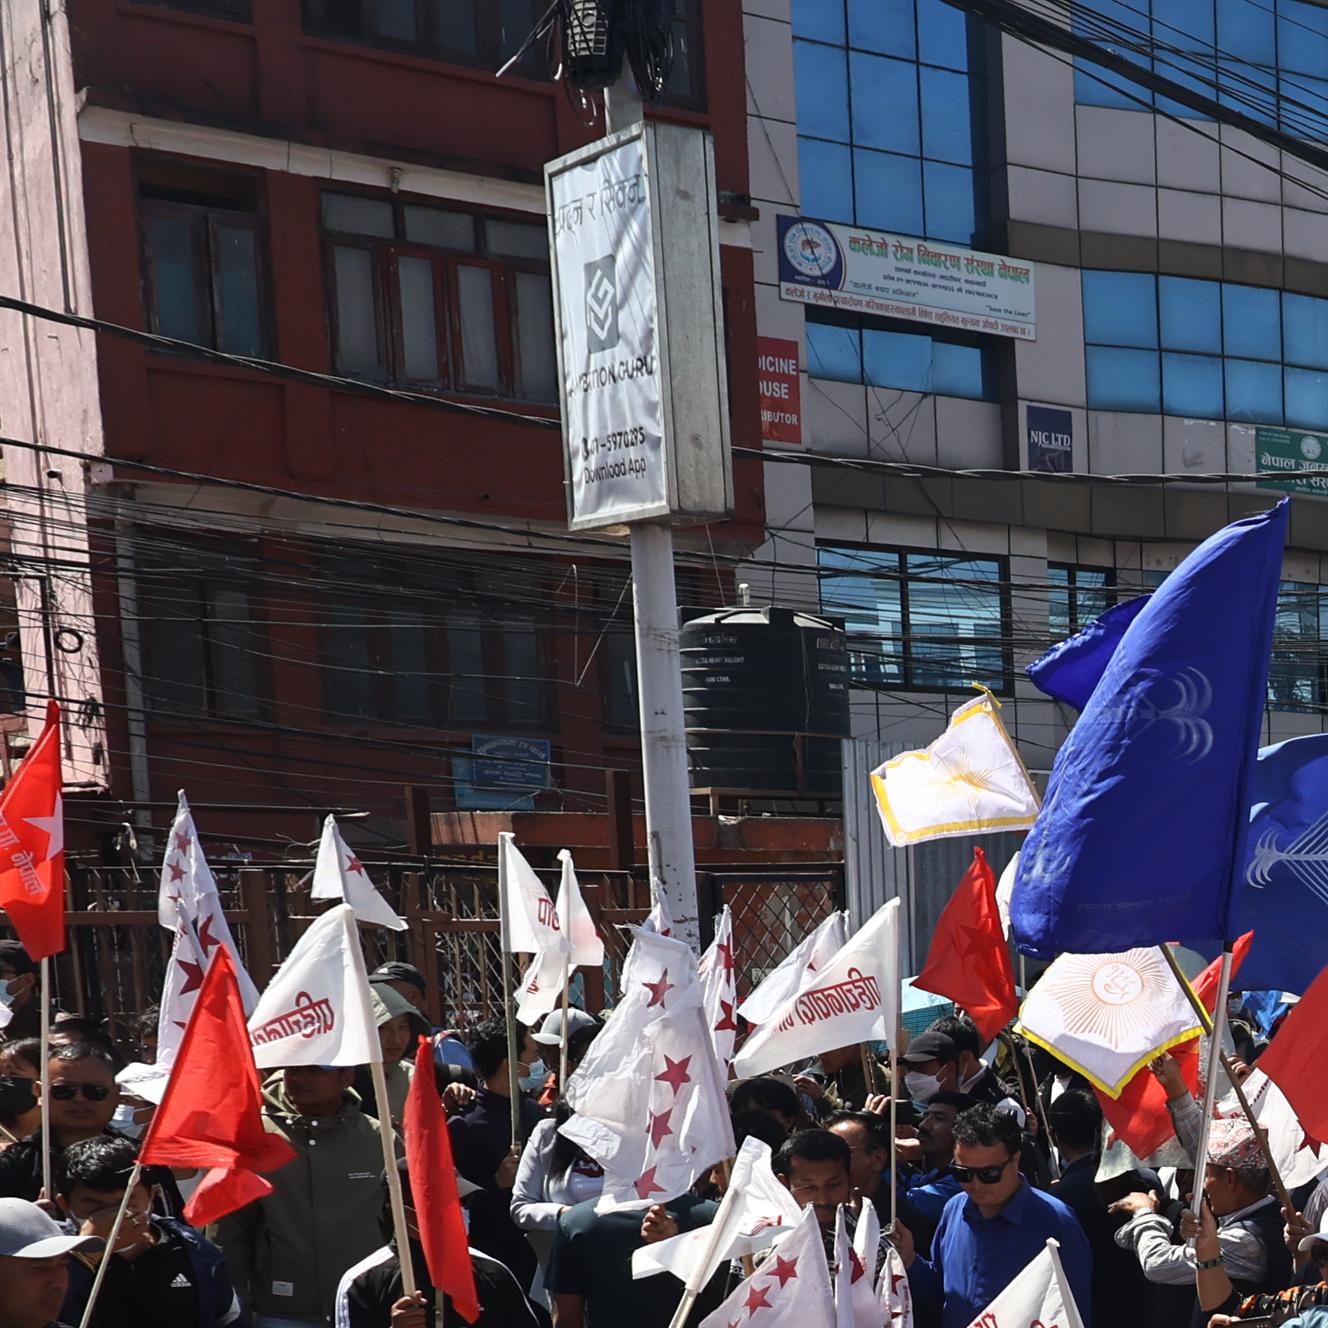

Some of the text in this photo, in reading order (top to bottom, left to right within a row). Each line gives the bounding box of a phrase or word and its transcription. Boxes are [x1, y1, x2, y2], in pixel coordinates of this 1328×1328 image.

[998, 260, 1030, 284] नेपाल
[1030, 430, 1071, 449] NJC LTD
[584, 455, 647, 485] Download App
[1260, 452, 1296, 470] नेपाल
